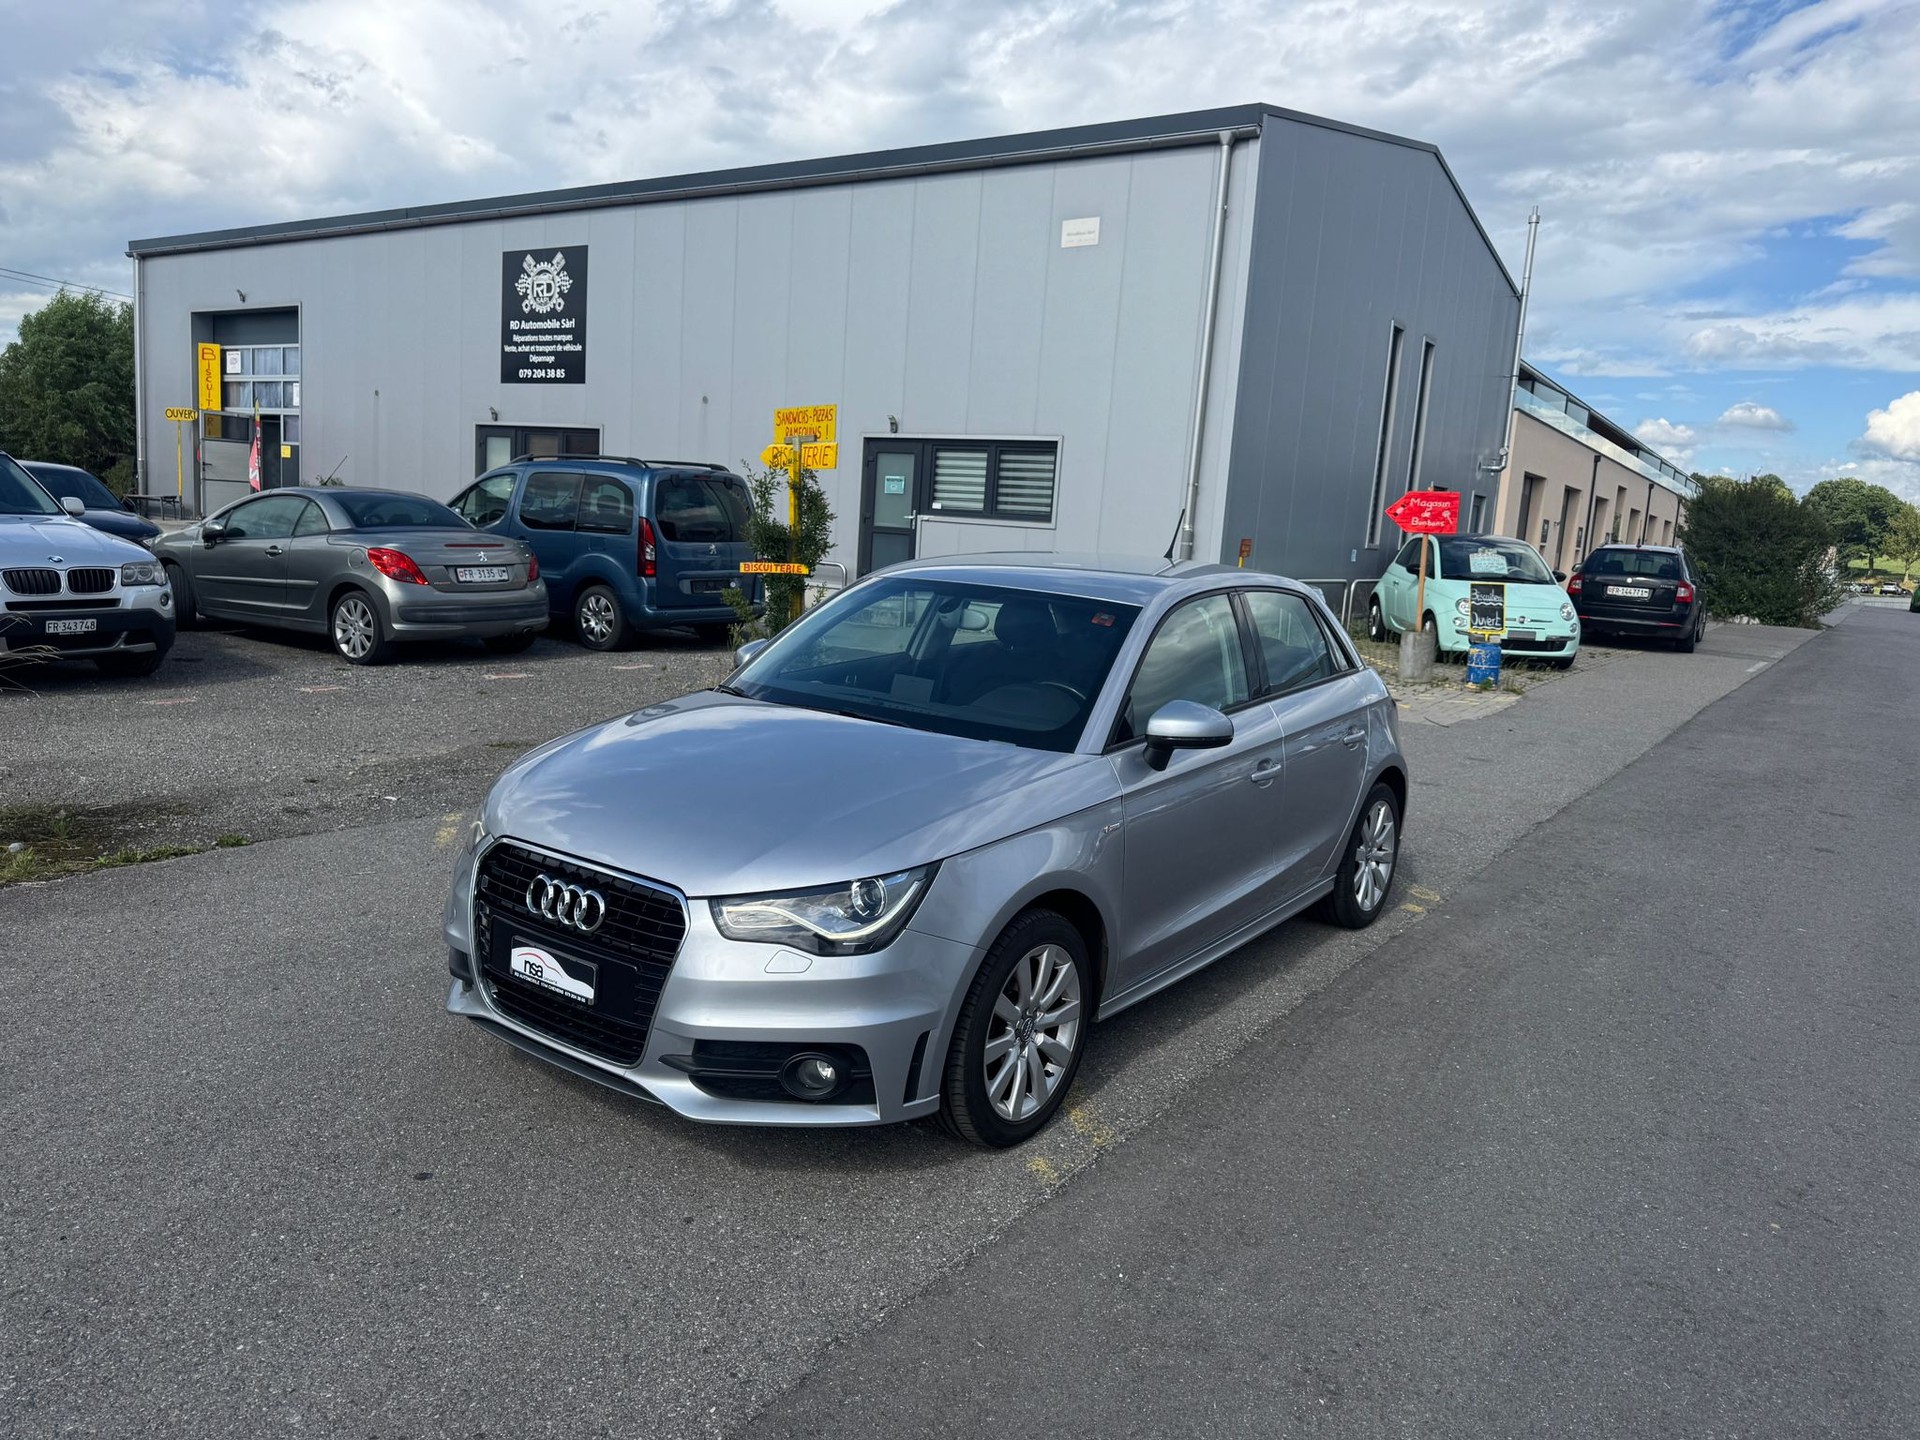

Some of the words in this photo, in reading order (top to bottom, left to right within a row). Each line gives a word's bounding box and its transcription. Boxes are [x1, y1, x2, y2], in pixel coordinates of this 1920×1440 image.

[533, 280, 555, 297] RD
[510, 320, 520, 330] RD
[521, 319, 560, 329] Automobile
[519, 369, 531, 378] 079
[533, 369, 545, 378] 204
[547, 369, 555, 378] 38
[556, 369, 565, 378] 85
[165, 408, 196, 420] OUVERT
[1410, 498, 1451, 511] Magasin
[1421, 510, 1431, 518] de
[1411, 517, 1445, 527] Bonbons
[743, 563, 802, 573] BISCUITERIE
[1472, 611, 1501, 627] Ouvert
[524, 960, 543, 978] nsa
